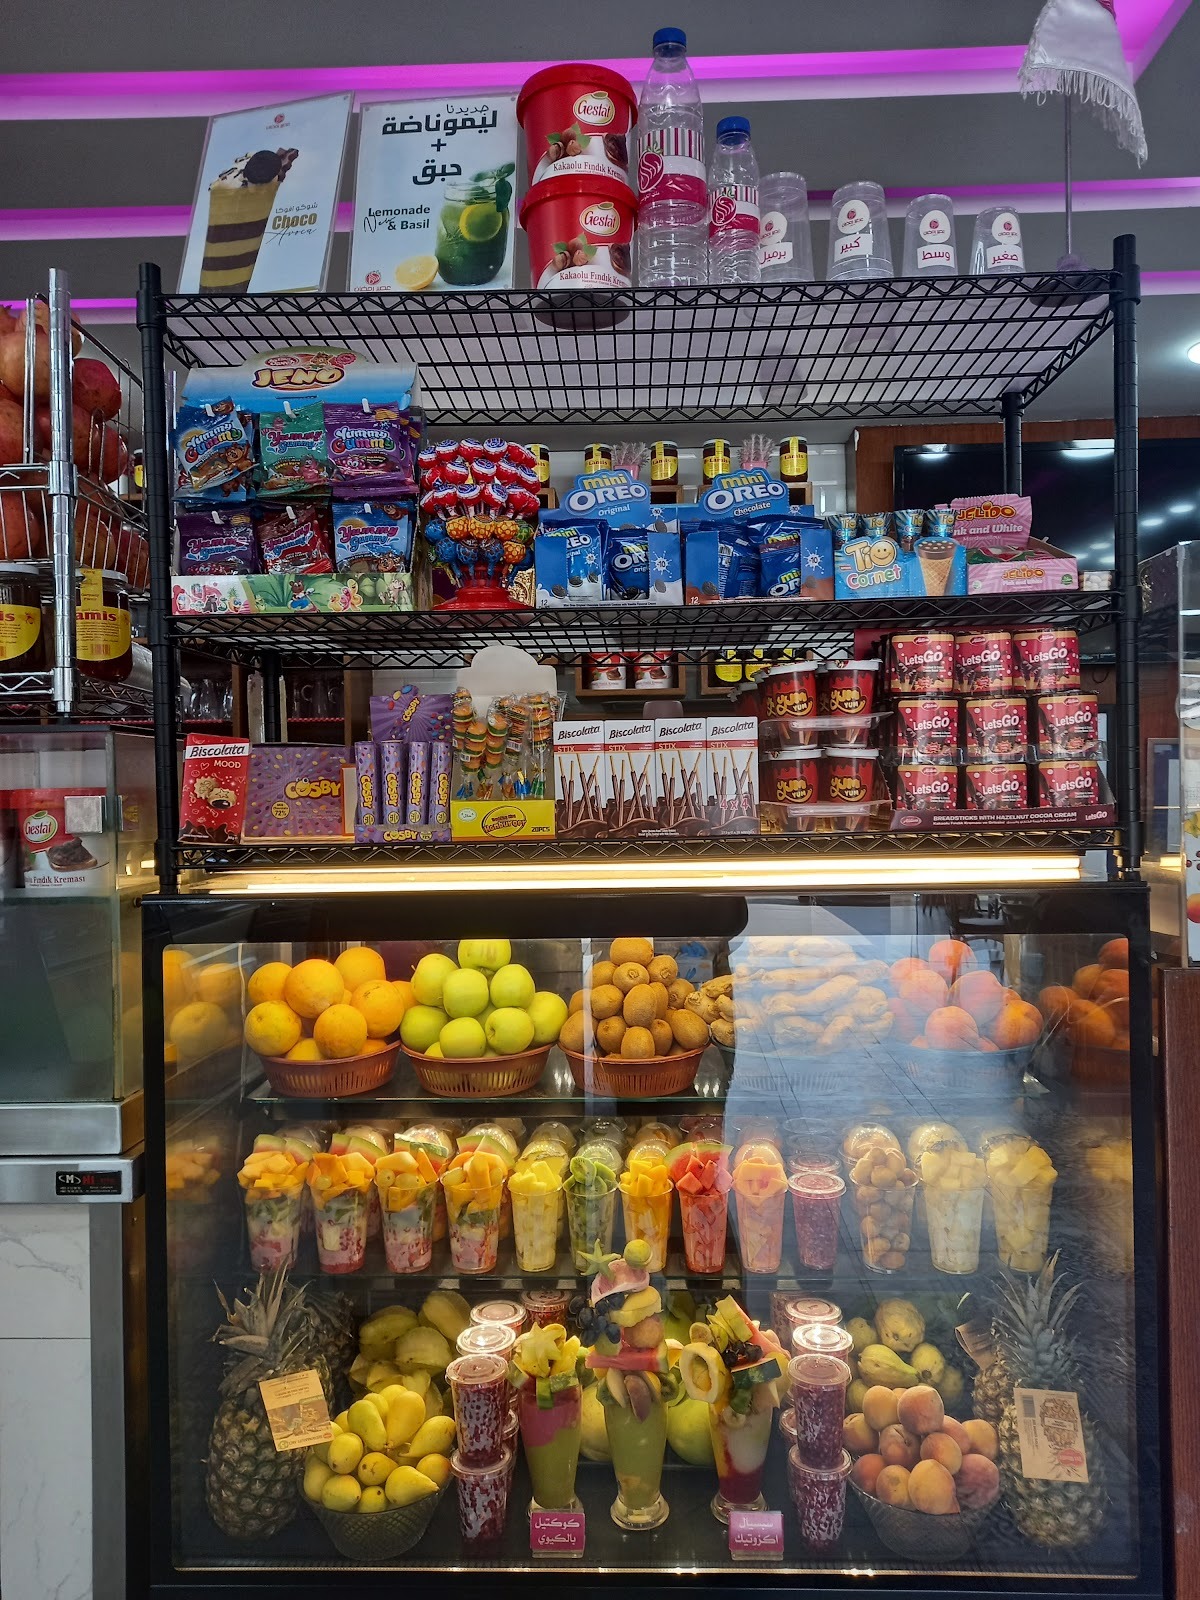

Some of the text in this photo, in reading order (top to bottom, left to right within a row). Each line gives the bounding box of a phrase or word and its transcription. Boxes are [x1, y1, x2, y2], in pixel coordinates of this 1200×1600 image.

[381, 110, 498, 136] ليموناضة
[412, 158, 463, 186] حبق
[553, 161, 582, 172] Kakaolu
[368, 204, 431, 217] Lemonade
[272, 213, 318, 231] Choco
[387, 218, 430, 231] & Basil
[839, 236, 861, 255] كبير
[921, 250, 951, 261] وسط
[991, 250, 1019, 265] صغير
[559, 270, 589, 281] Kakaolu
[254, 367, 344, 388] JENO
[582, 473, 627, 491] mini
[721, 473, 765, 490] mini
[569, 484, 647, 512] OREO
[707, 483, 784, 510] OREO
[733, 501, 771, 517] Chocolate
[338, 524, 399, 542] Yummy
[954, 527, 967, 536] nk
[969, 525, 990, 535] and
[992, 524, 1024, 533] White
[614, 552, 648, 569] OR
[846, 564, 902, 590] Cornet
[76, 610, 117, 622] amis
[904, 650, 943, 666] LetsGo
[962, 650, 1001, 666] LetsGo
[1029, 647, 1068, 663] LetsGo
[913, 715, 950, 731] LetsGo
[983, 714, 1020, 731] LetsGo
[1055, 710, 1092, 727] LetsGo
[558, 725, 601, 741] Biscolata
[609, 724, 652, 740] Biscolata
[659, 722, 703, 738] Biscolata
[710, 721, 755, 737] Biscolata
[189, 744, 246, 758] Biscolata
[557, 745, 575, 753] STIX
[608, 744, 627, 752] STIX
[659, 742, 677, 750] STIX
[710, 741, 729, 749] STIX
[213, 760, 241, 769] MOOD
[285, 778, 342, 799] COSBY
[912, 779, 950, 795] LetsGo
[982, 779, 1020, 795] LetsGo
[1055, 776, 1093, 792] LetsGo
[720, 800, 728, 810] 4
[741, 798, 750, 810] 4
[933, 814, 978, 822] BREADSTICKS
[996, 813, 1029, 821] HAZELNUT
[1030, 812, 1053, 820] COCOA
[1085, 811, 1108, 822] LetsGo
[383, 829, 418, 842] COSBY
[53, 875, 86, 884] Kreması
[534, 1517, 580, 1529] كوكتيل
[537, 1534, 577, 1547] بالكيوي
